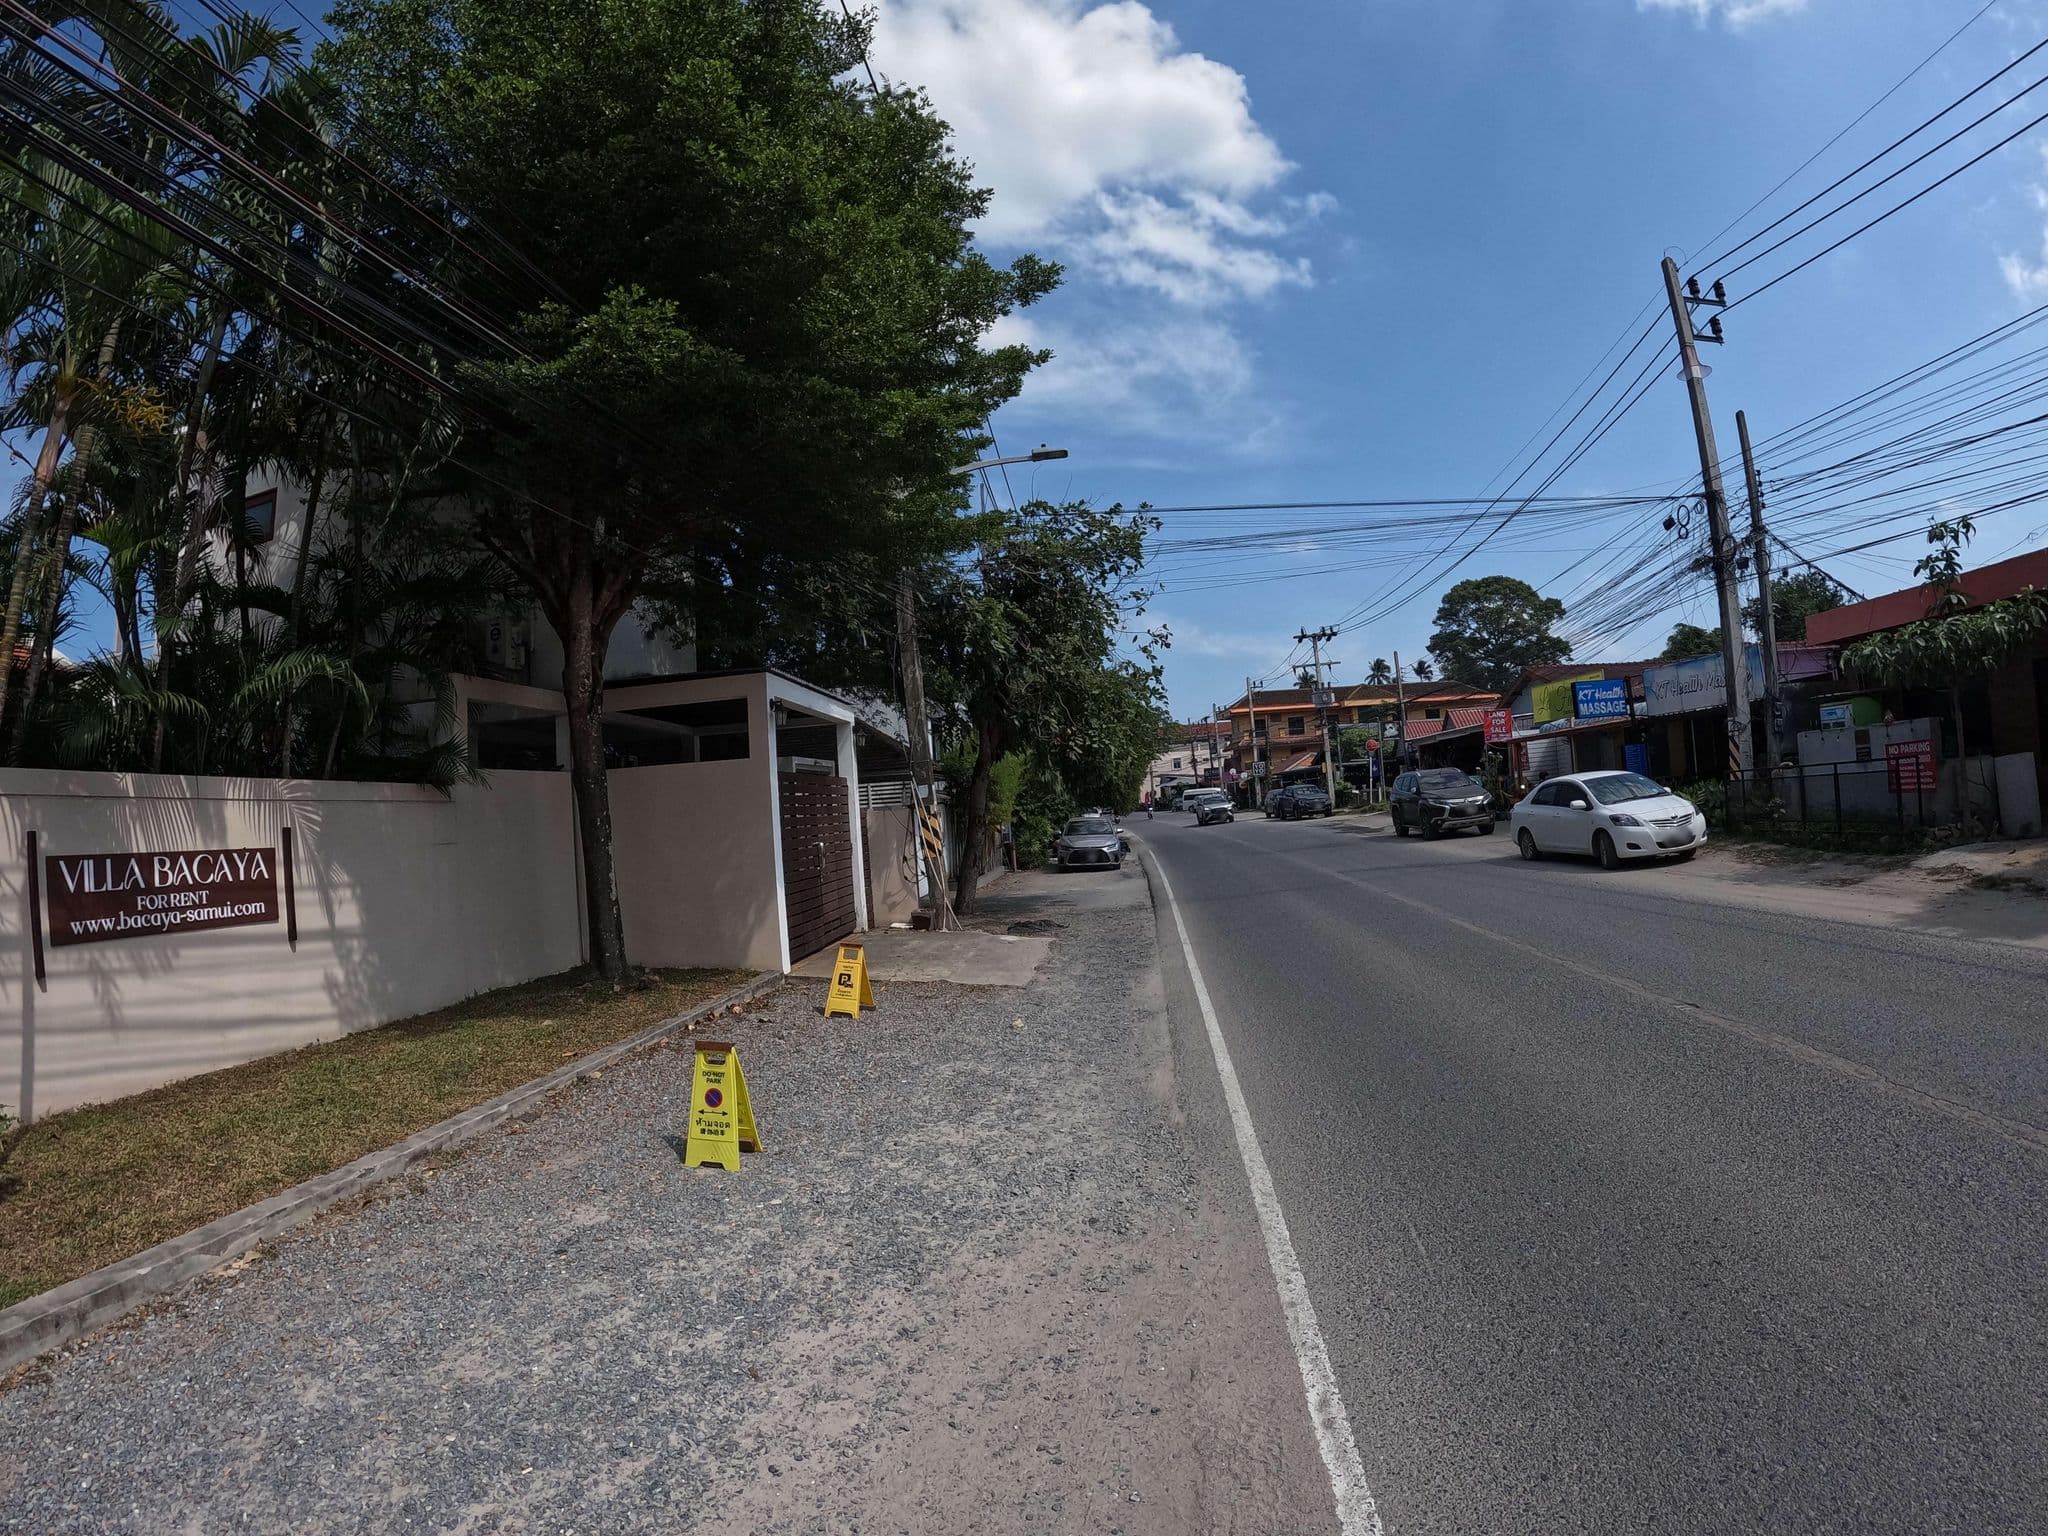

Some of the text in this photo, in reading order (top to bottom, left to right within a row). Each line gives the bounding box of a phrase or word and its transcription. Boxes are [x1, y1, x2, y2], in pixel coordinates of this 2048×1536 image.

[1577, 689, 1596, 701] KT
[1594, 685, 1625, 700] Health
[1656, 679, 1671, 700] KT
[1670, 674, 1703, 697] Health
[1579, 700, 1627, 716] MASSAGE
[1492, 718, 1506, 726] FOR
[1888, 741, 1930, 755] NO PARKING
[58, 851, 269, 894] VILLA BACAYA
[137, 890, 210, 911] FOR RENT
[69, 901, 266, 936] www.bacaya-samui.com
